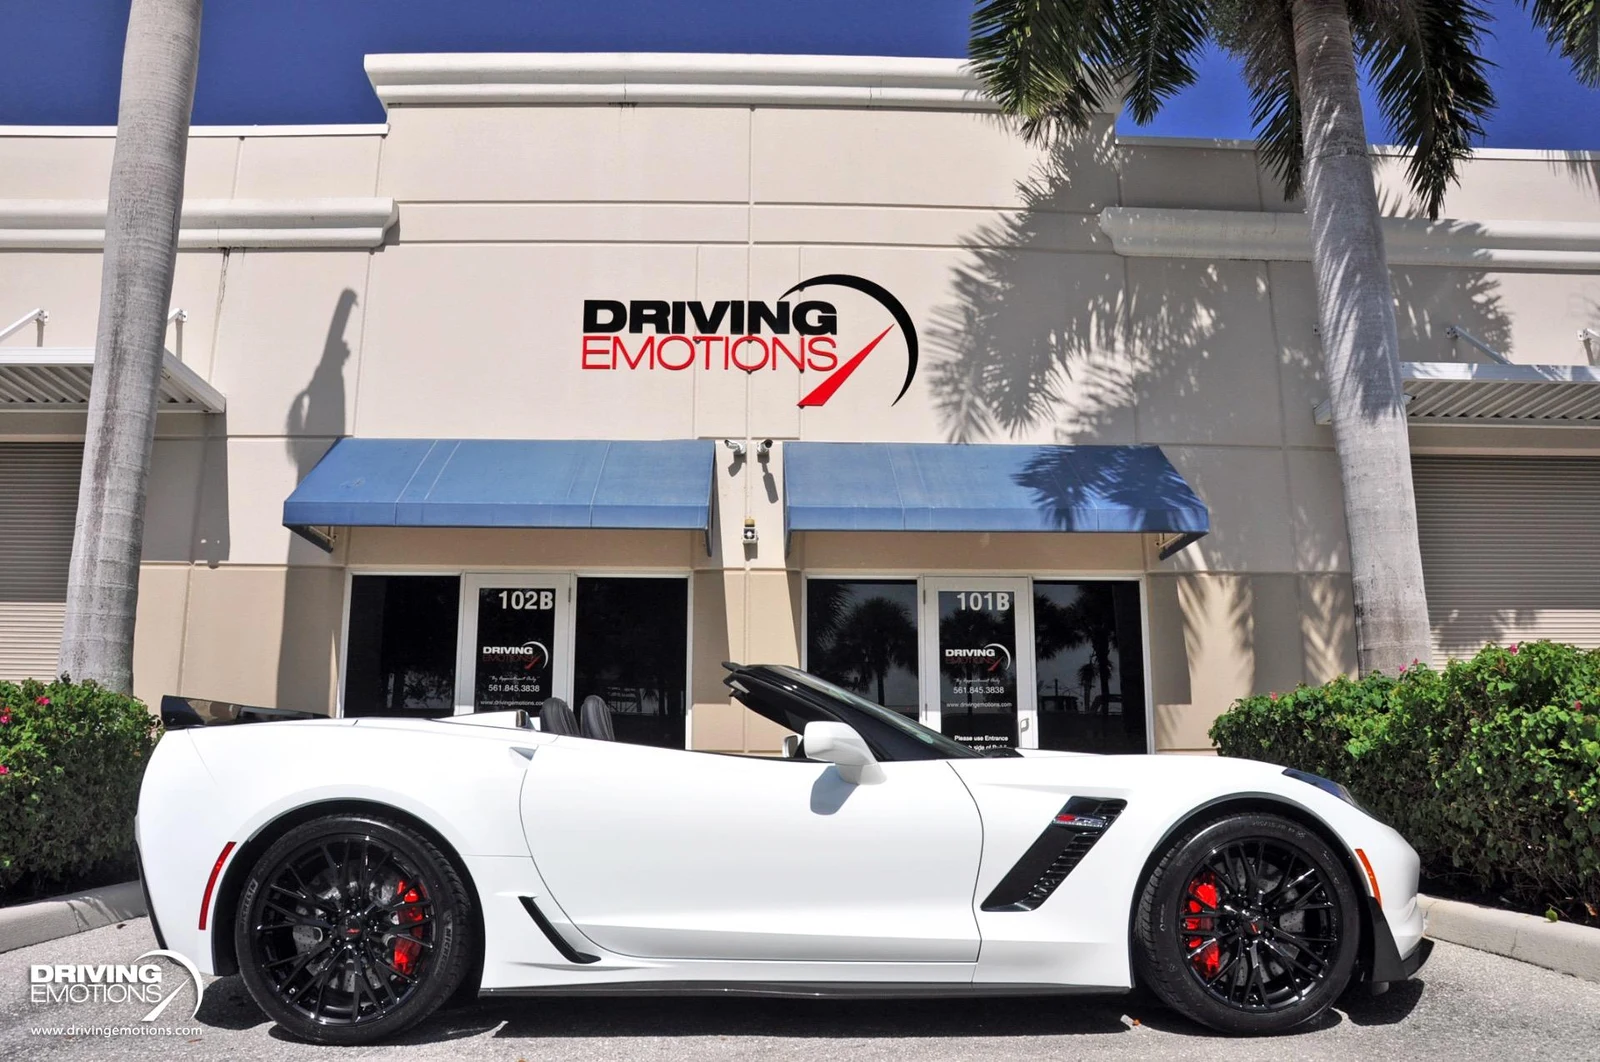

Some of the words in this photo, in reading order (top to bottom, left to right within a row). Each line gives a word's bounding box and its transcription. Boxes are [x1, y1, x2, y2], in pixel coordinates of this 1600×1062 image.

[583, 300, 837, 335] DRIVING
[581, 336, 838, 371] EMOTIONS
[499, 591, 553, 610] 102B
[957, 592, 1010, 611] 101B
[483, 646, 533, 654] DRIVING
[945, 649, 995, 657] DRIVING
[953, 686, 1005, 694] 561.845.3838
